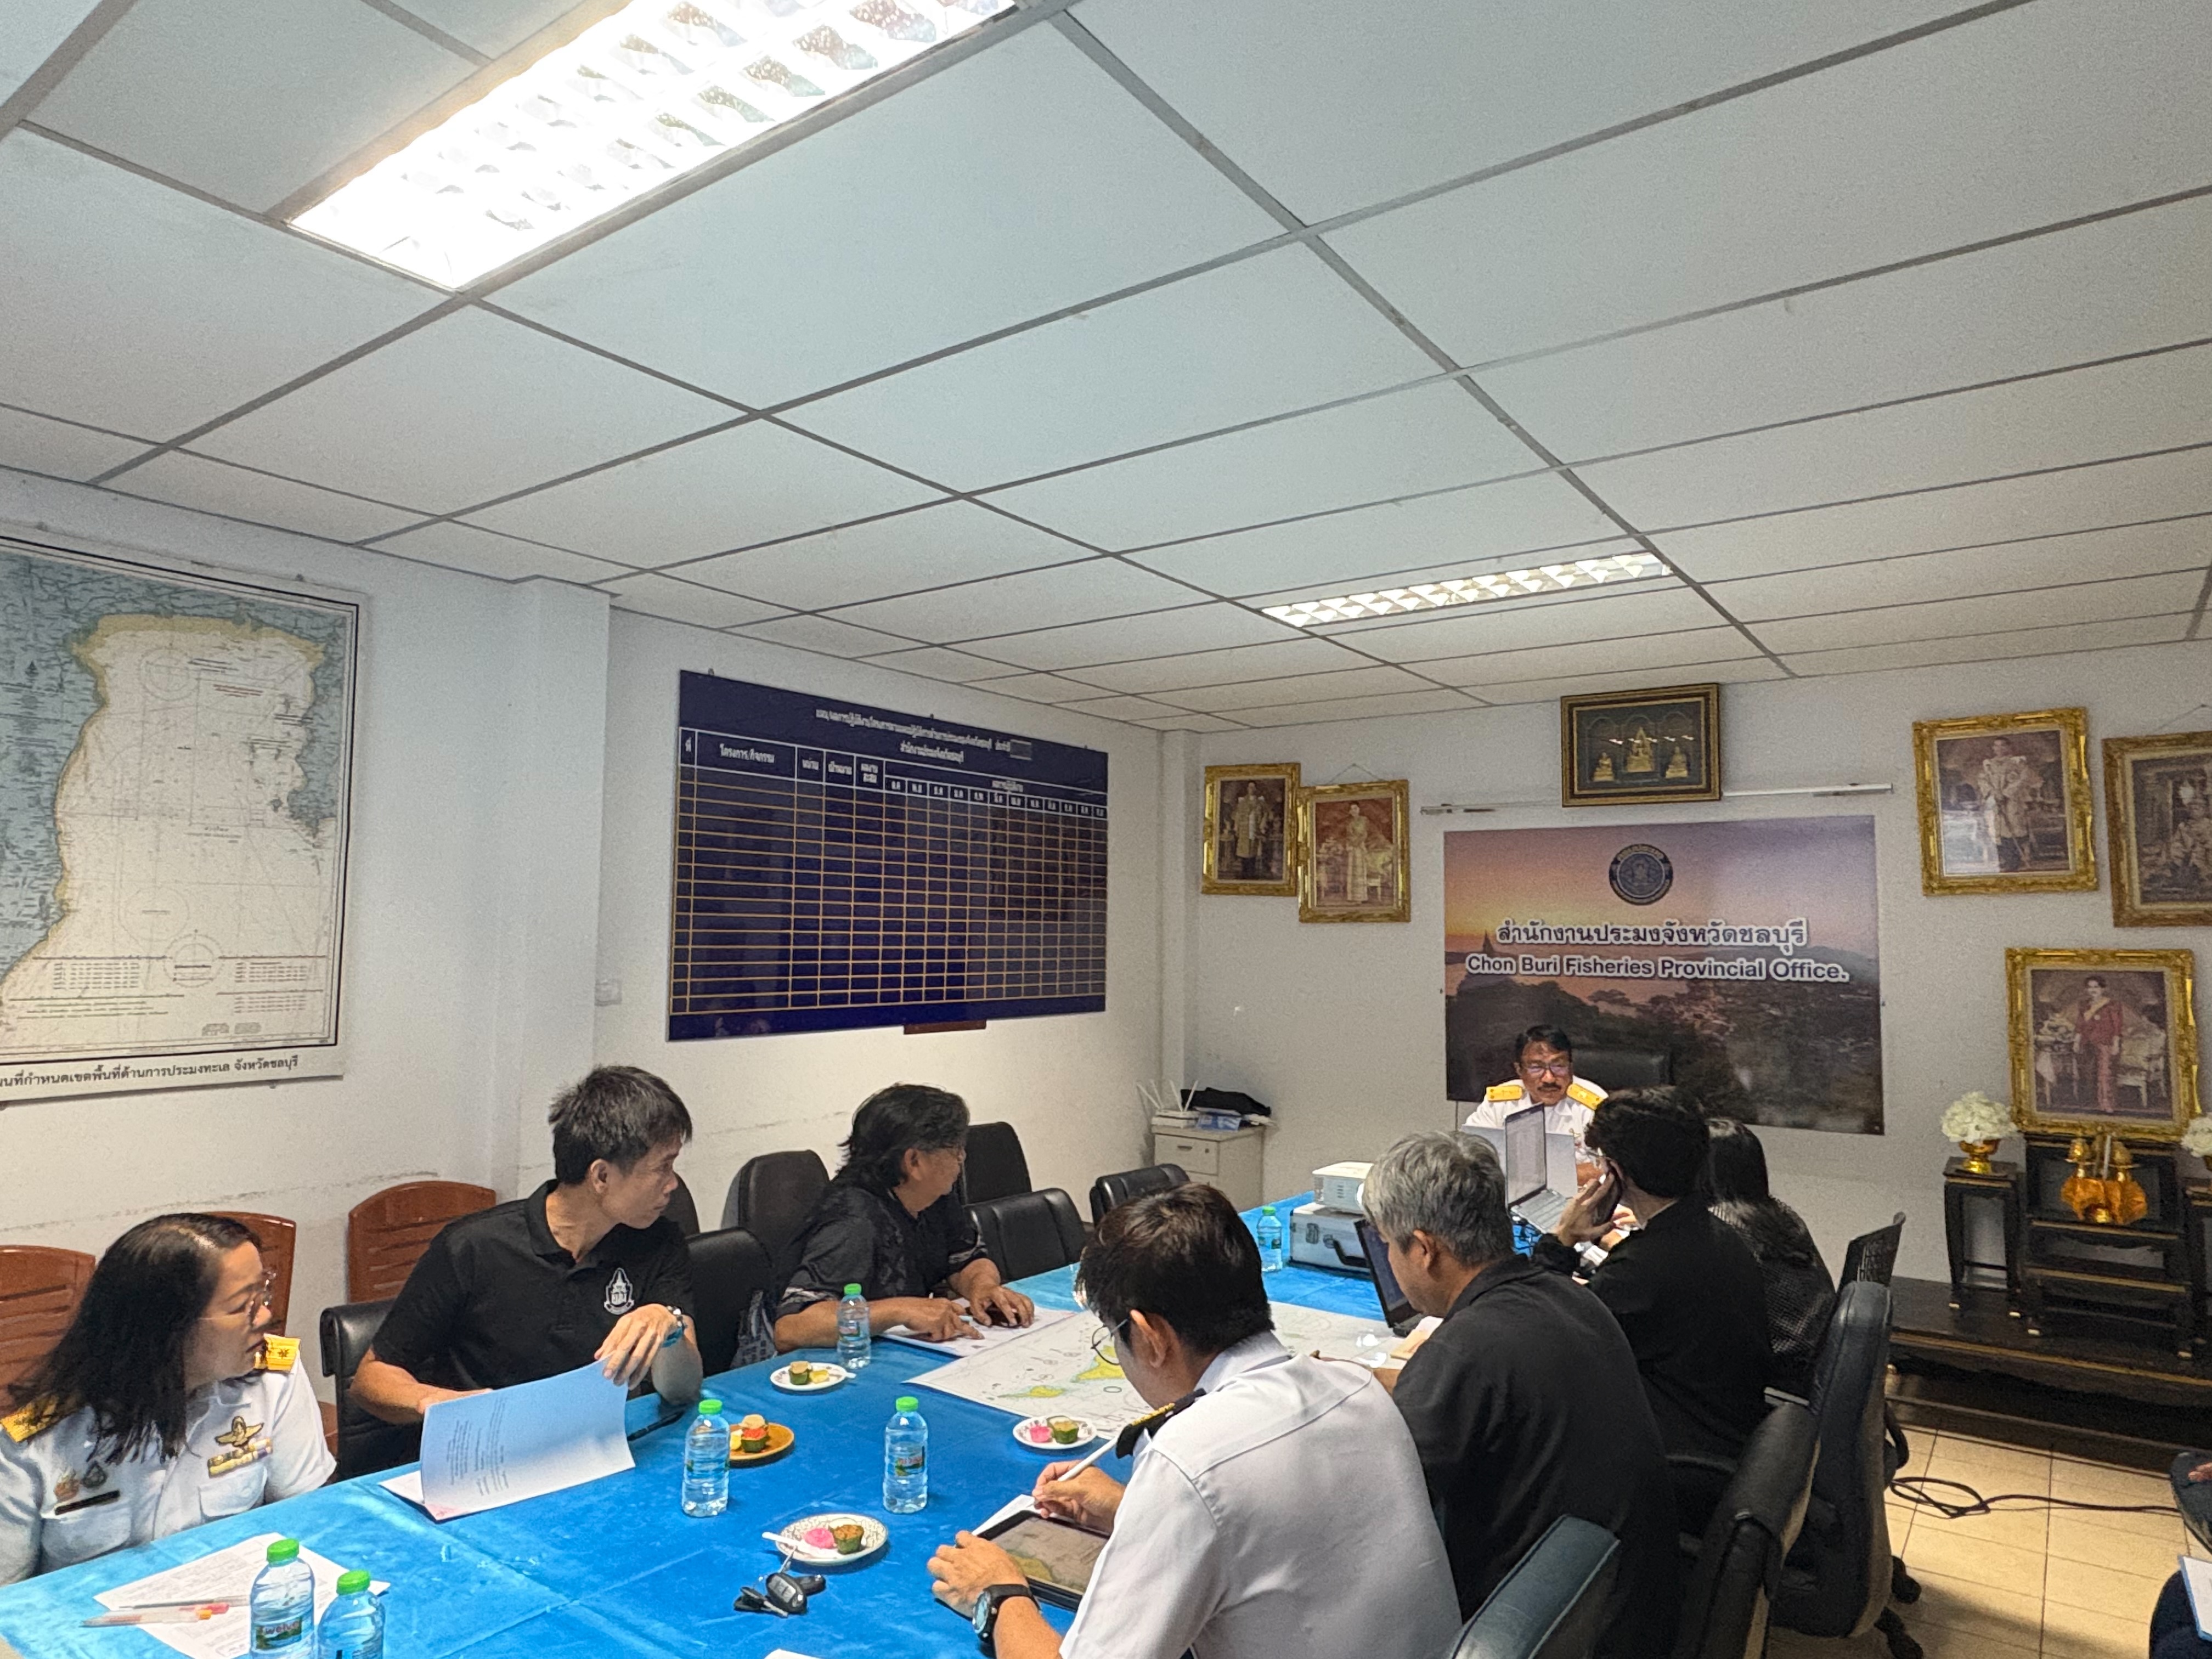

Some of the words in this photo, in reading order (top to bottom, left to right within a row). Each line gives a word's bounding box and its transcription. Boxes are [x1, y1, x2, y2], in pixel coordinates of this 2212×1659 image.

[1498, 919, 1805, 953] สำนักงานประมงจังหวัดชลบุรี
[1468, 956, 1514, 970] Chon
[1521, 956, 1558, 972] Buri
[1566, 957, 1653, 974] Fisheries
[1661, 959, 1763, 977] Provincial
[1772, 960, 1847, 979] Office.
[234, 1054, 298, 1070] จังหวัดชลบุรี
